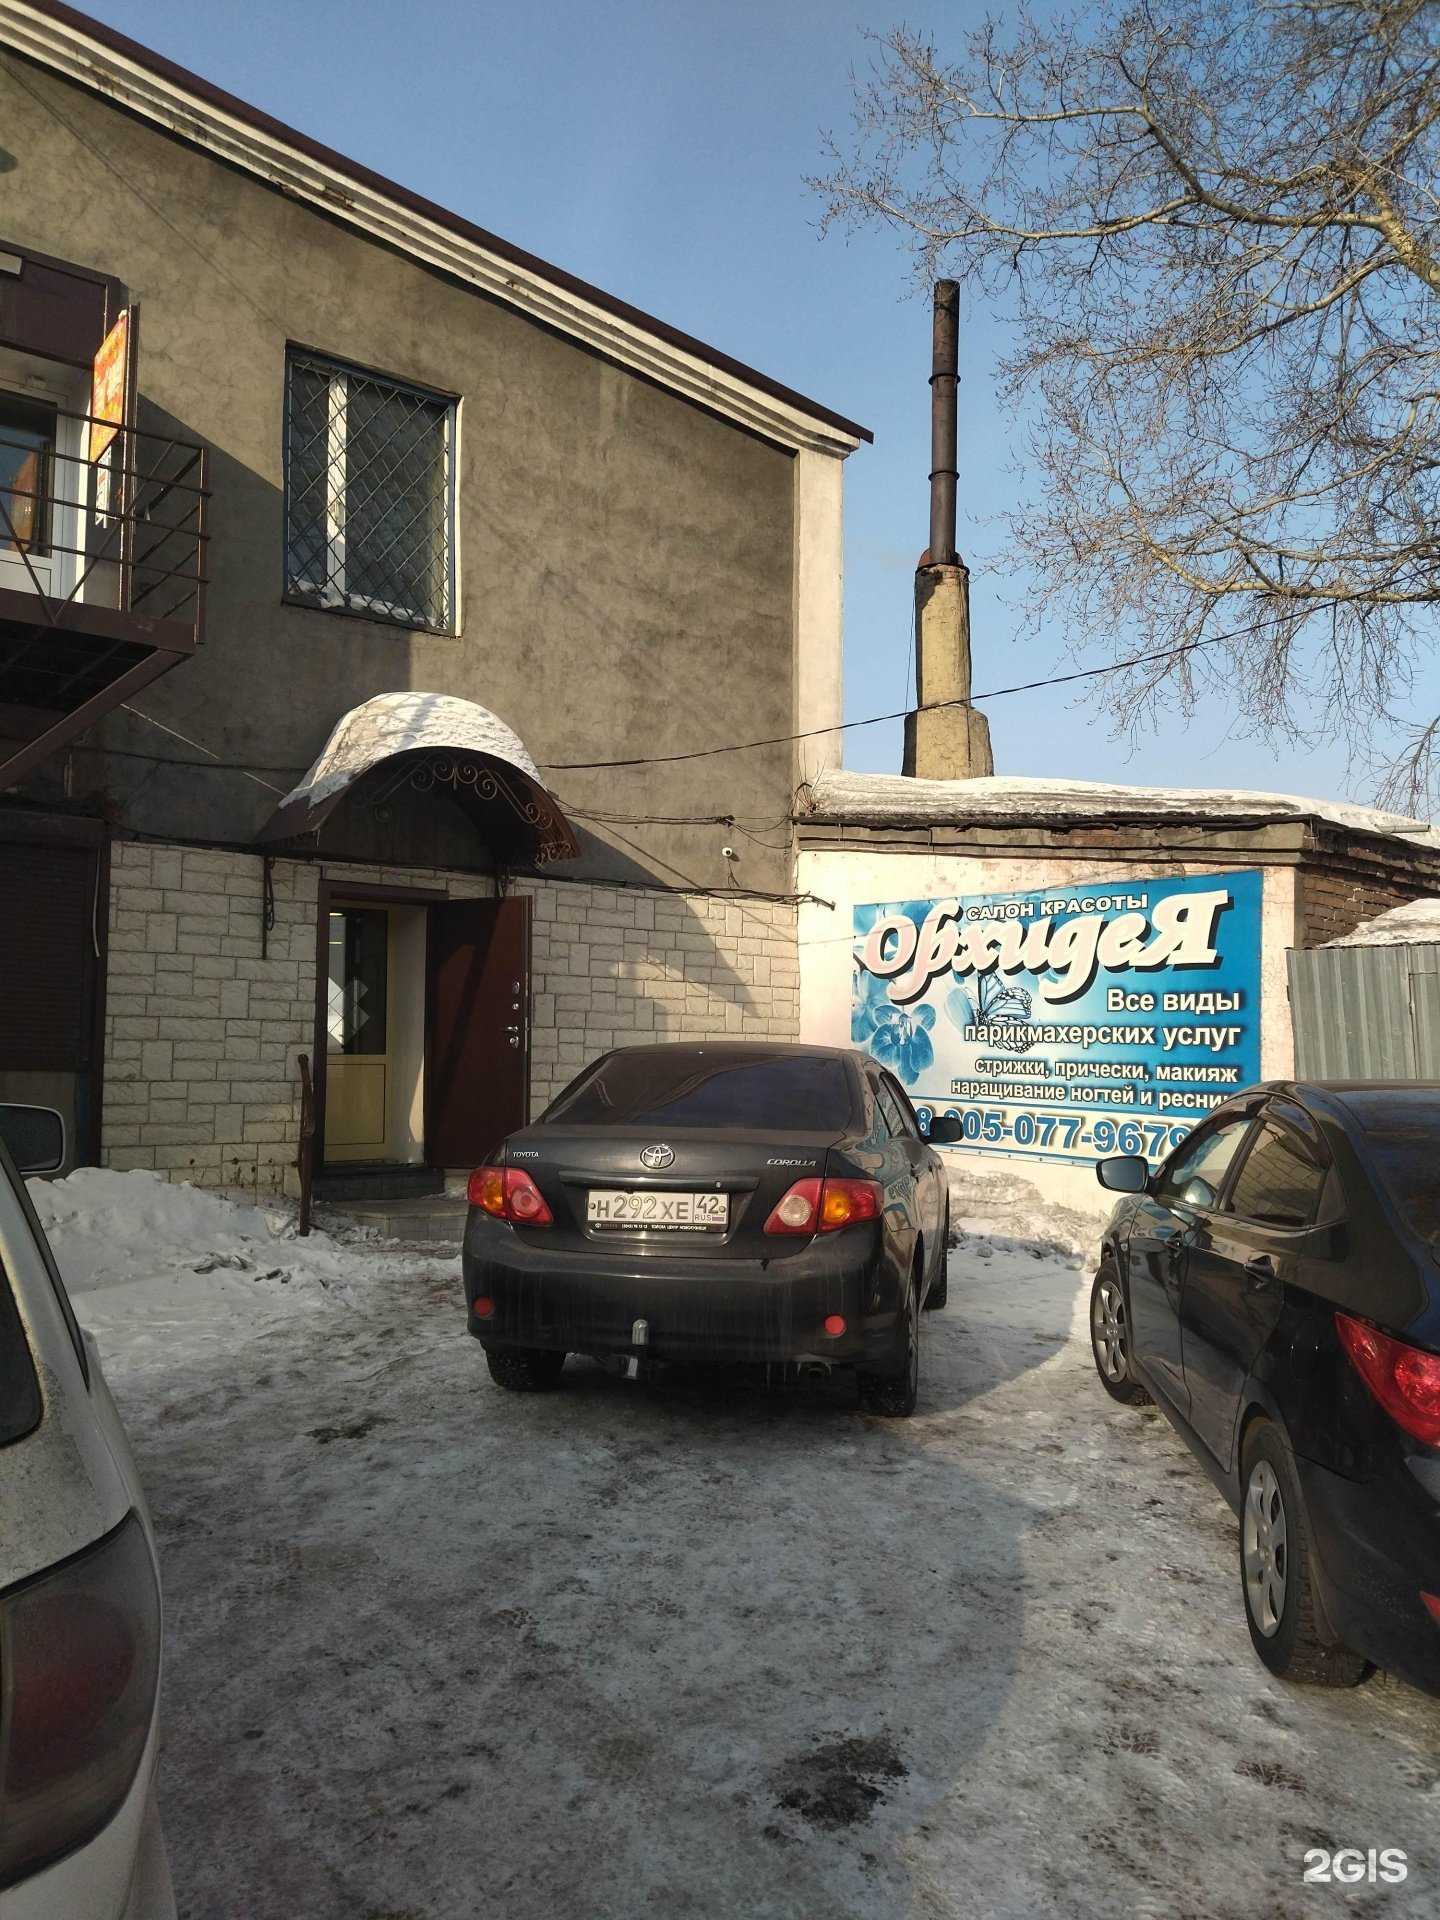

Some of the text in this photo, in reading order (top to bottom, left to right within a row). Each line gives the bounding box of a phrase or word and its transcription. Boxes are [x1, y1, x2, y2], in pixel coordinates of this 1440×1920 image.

[966, 893, 1149, 922] САЛОН КРАСОТЫ
[1106, 987, 1240, 1016] Все виды
[964, 1023, 1241, 1051] парикмахерских услуг
[974, 1058, 1239, 1084] стрижки, прически, макияж
[951, 1079, 1229, 1112] наращивание ногтей и ресни
[512, 1151, 540, 1159] TOYOTA
[766, 1158, 817, 1167] COROLLA
[696, 1195, 720, 1214] 42
